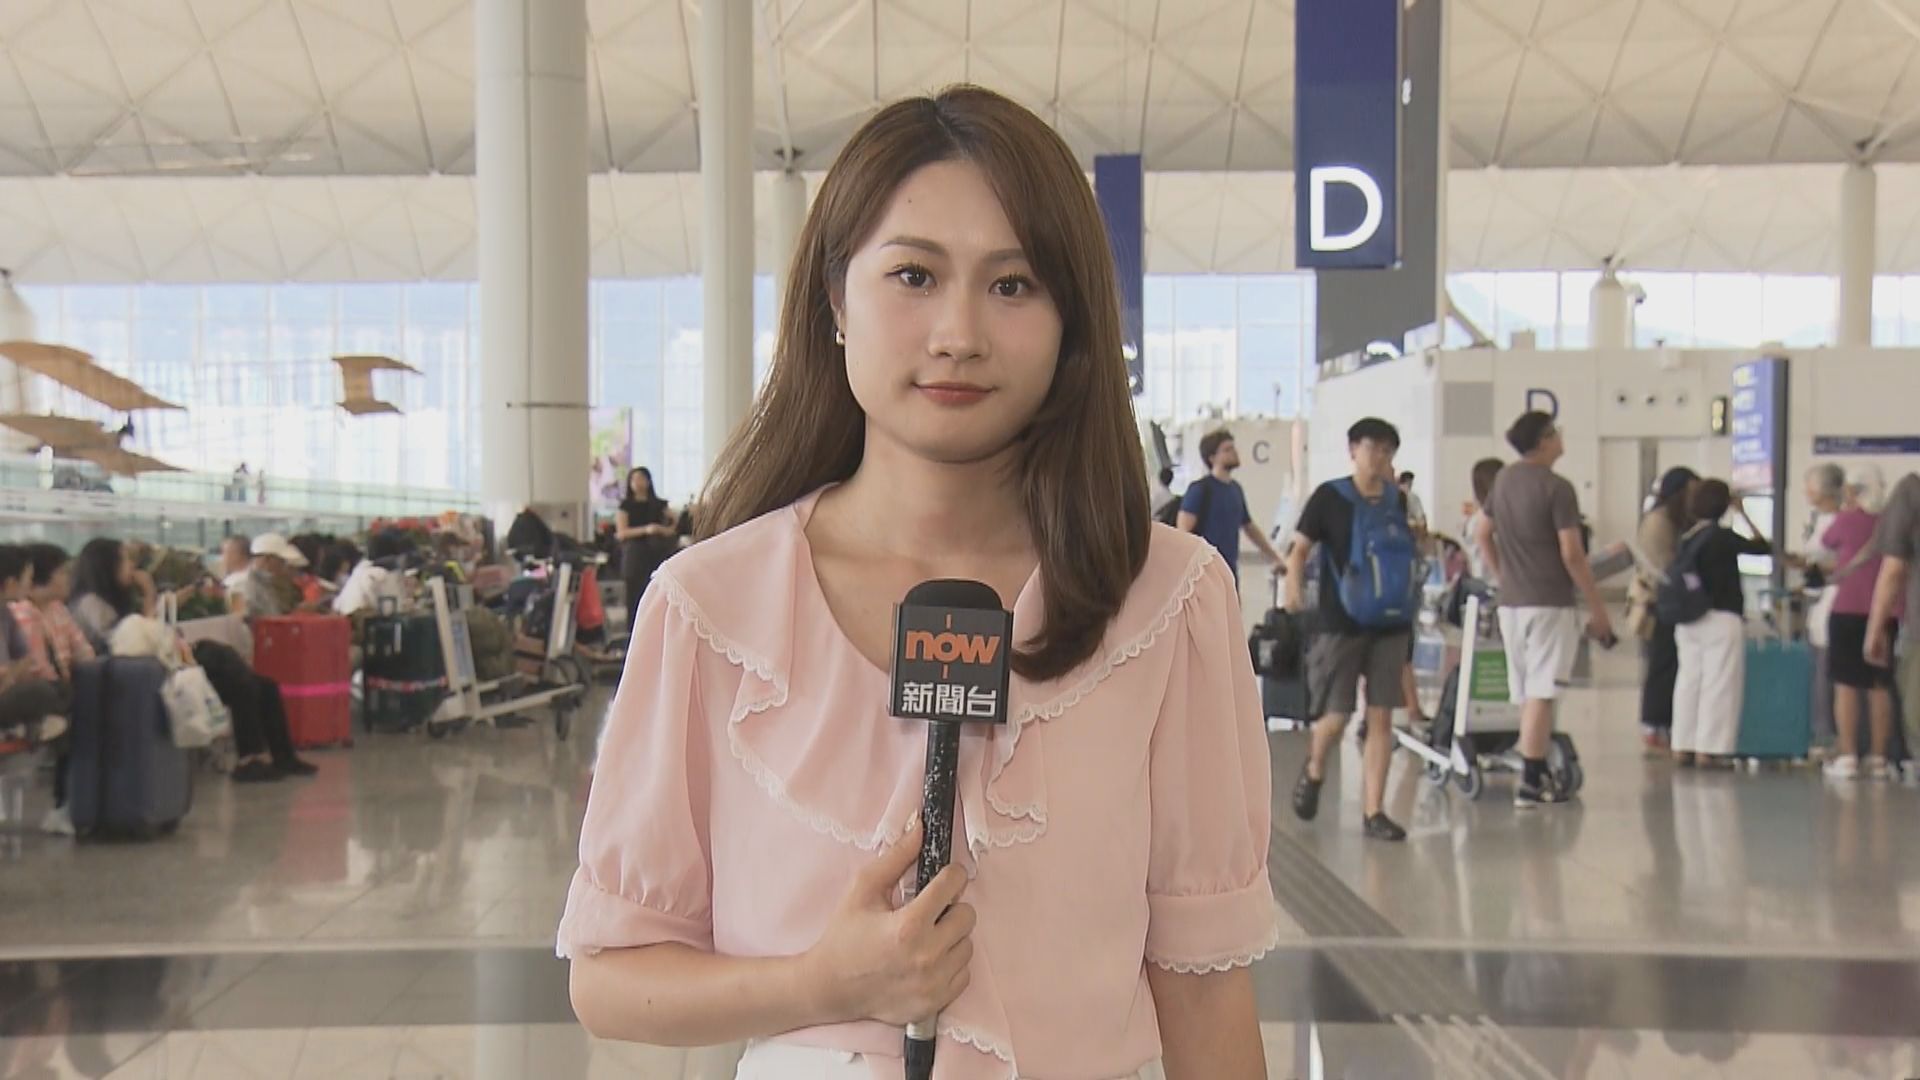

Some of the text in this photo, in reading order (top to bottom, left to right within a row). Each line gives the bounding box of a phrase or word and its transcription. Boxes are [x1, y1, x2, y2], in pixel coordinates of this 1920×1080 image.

[1310, 166, 1383, 252] D
[1252, 441, 1271, 464] C
[904, 629, 1001, 665] now
[901, 681, 997, 717] 新聞台
